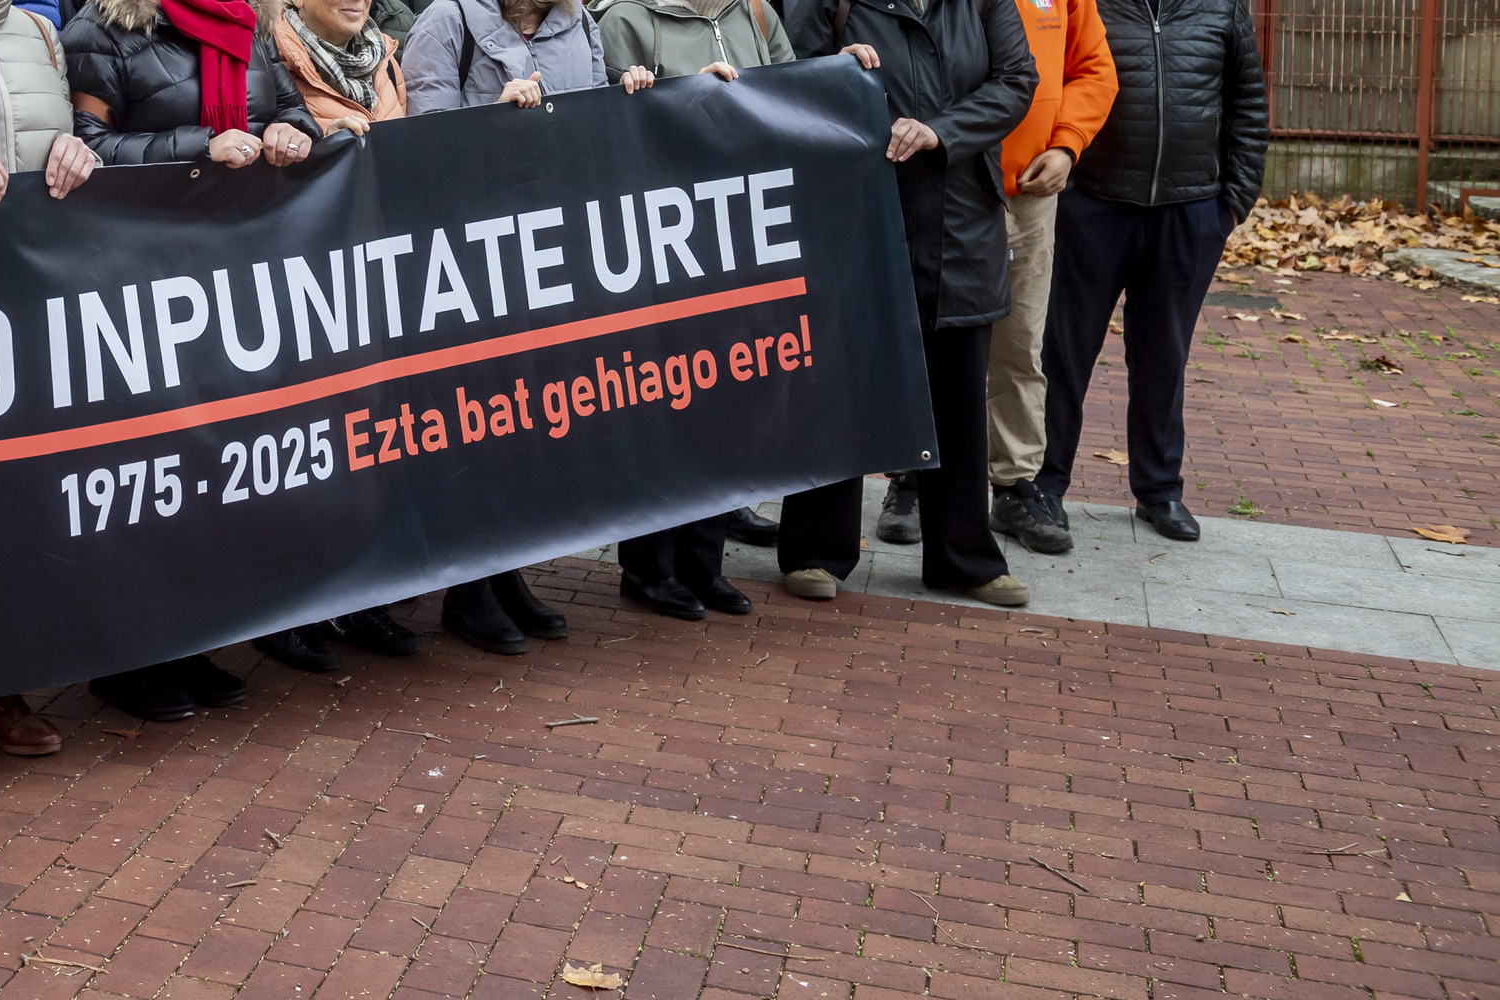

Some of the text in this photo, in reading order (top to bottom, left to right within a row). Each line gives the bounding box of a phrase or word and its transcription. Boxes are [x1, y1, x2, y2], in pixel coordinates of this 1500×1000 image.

[46, 206, 575, 409] INPUNITATE
[585, 167, 802, 294] URTE
[61, 453, 183, 537] 1975
[221, 418, 334, 505] 2025
[344, 403, 448, 472] Ezta
[455, 378, 534, 444] bat
[542, 349, 718, 439] gehiago
[729, 314, 813, 382] ere!
